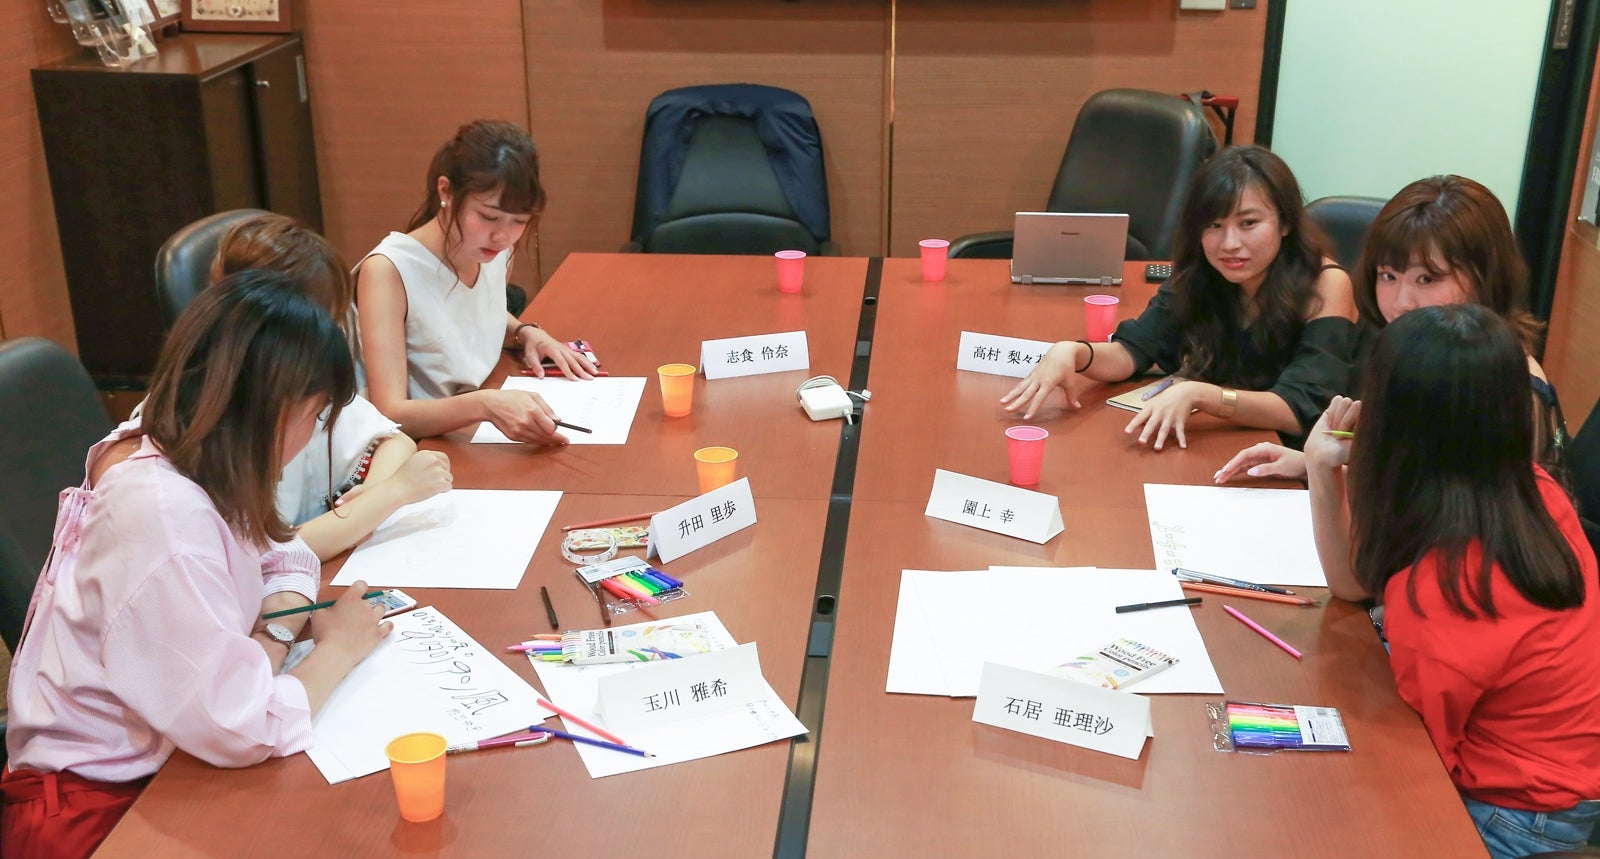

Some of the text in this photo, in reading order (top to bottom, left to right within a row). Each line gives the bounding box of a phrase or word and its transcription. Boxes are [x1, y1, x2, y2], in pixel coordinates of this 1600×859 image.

[726, 344, 788, 364] 志食 伶奈
[678, 500, 737, 540] 升田 里歩
[962, 499, 1014, 523] 園上 幸
[586, 631, 596, 657] Wood Free
[598, 645, 606, 656] Color
[1103, 647, 1123, 660] Color
[1110, 643, 1136, 658] Wood
[1136, 656, 1157, 667] Free
[642, 678, 727, 712] 玉川 雅希
[1003, 696, 1114, 736] 石居 亜理沙
